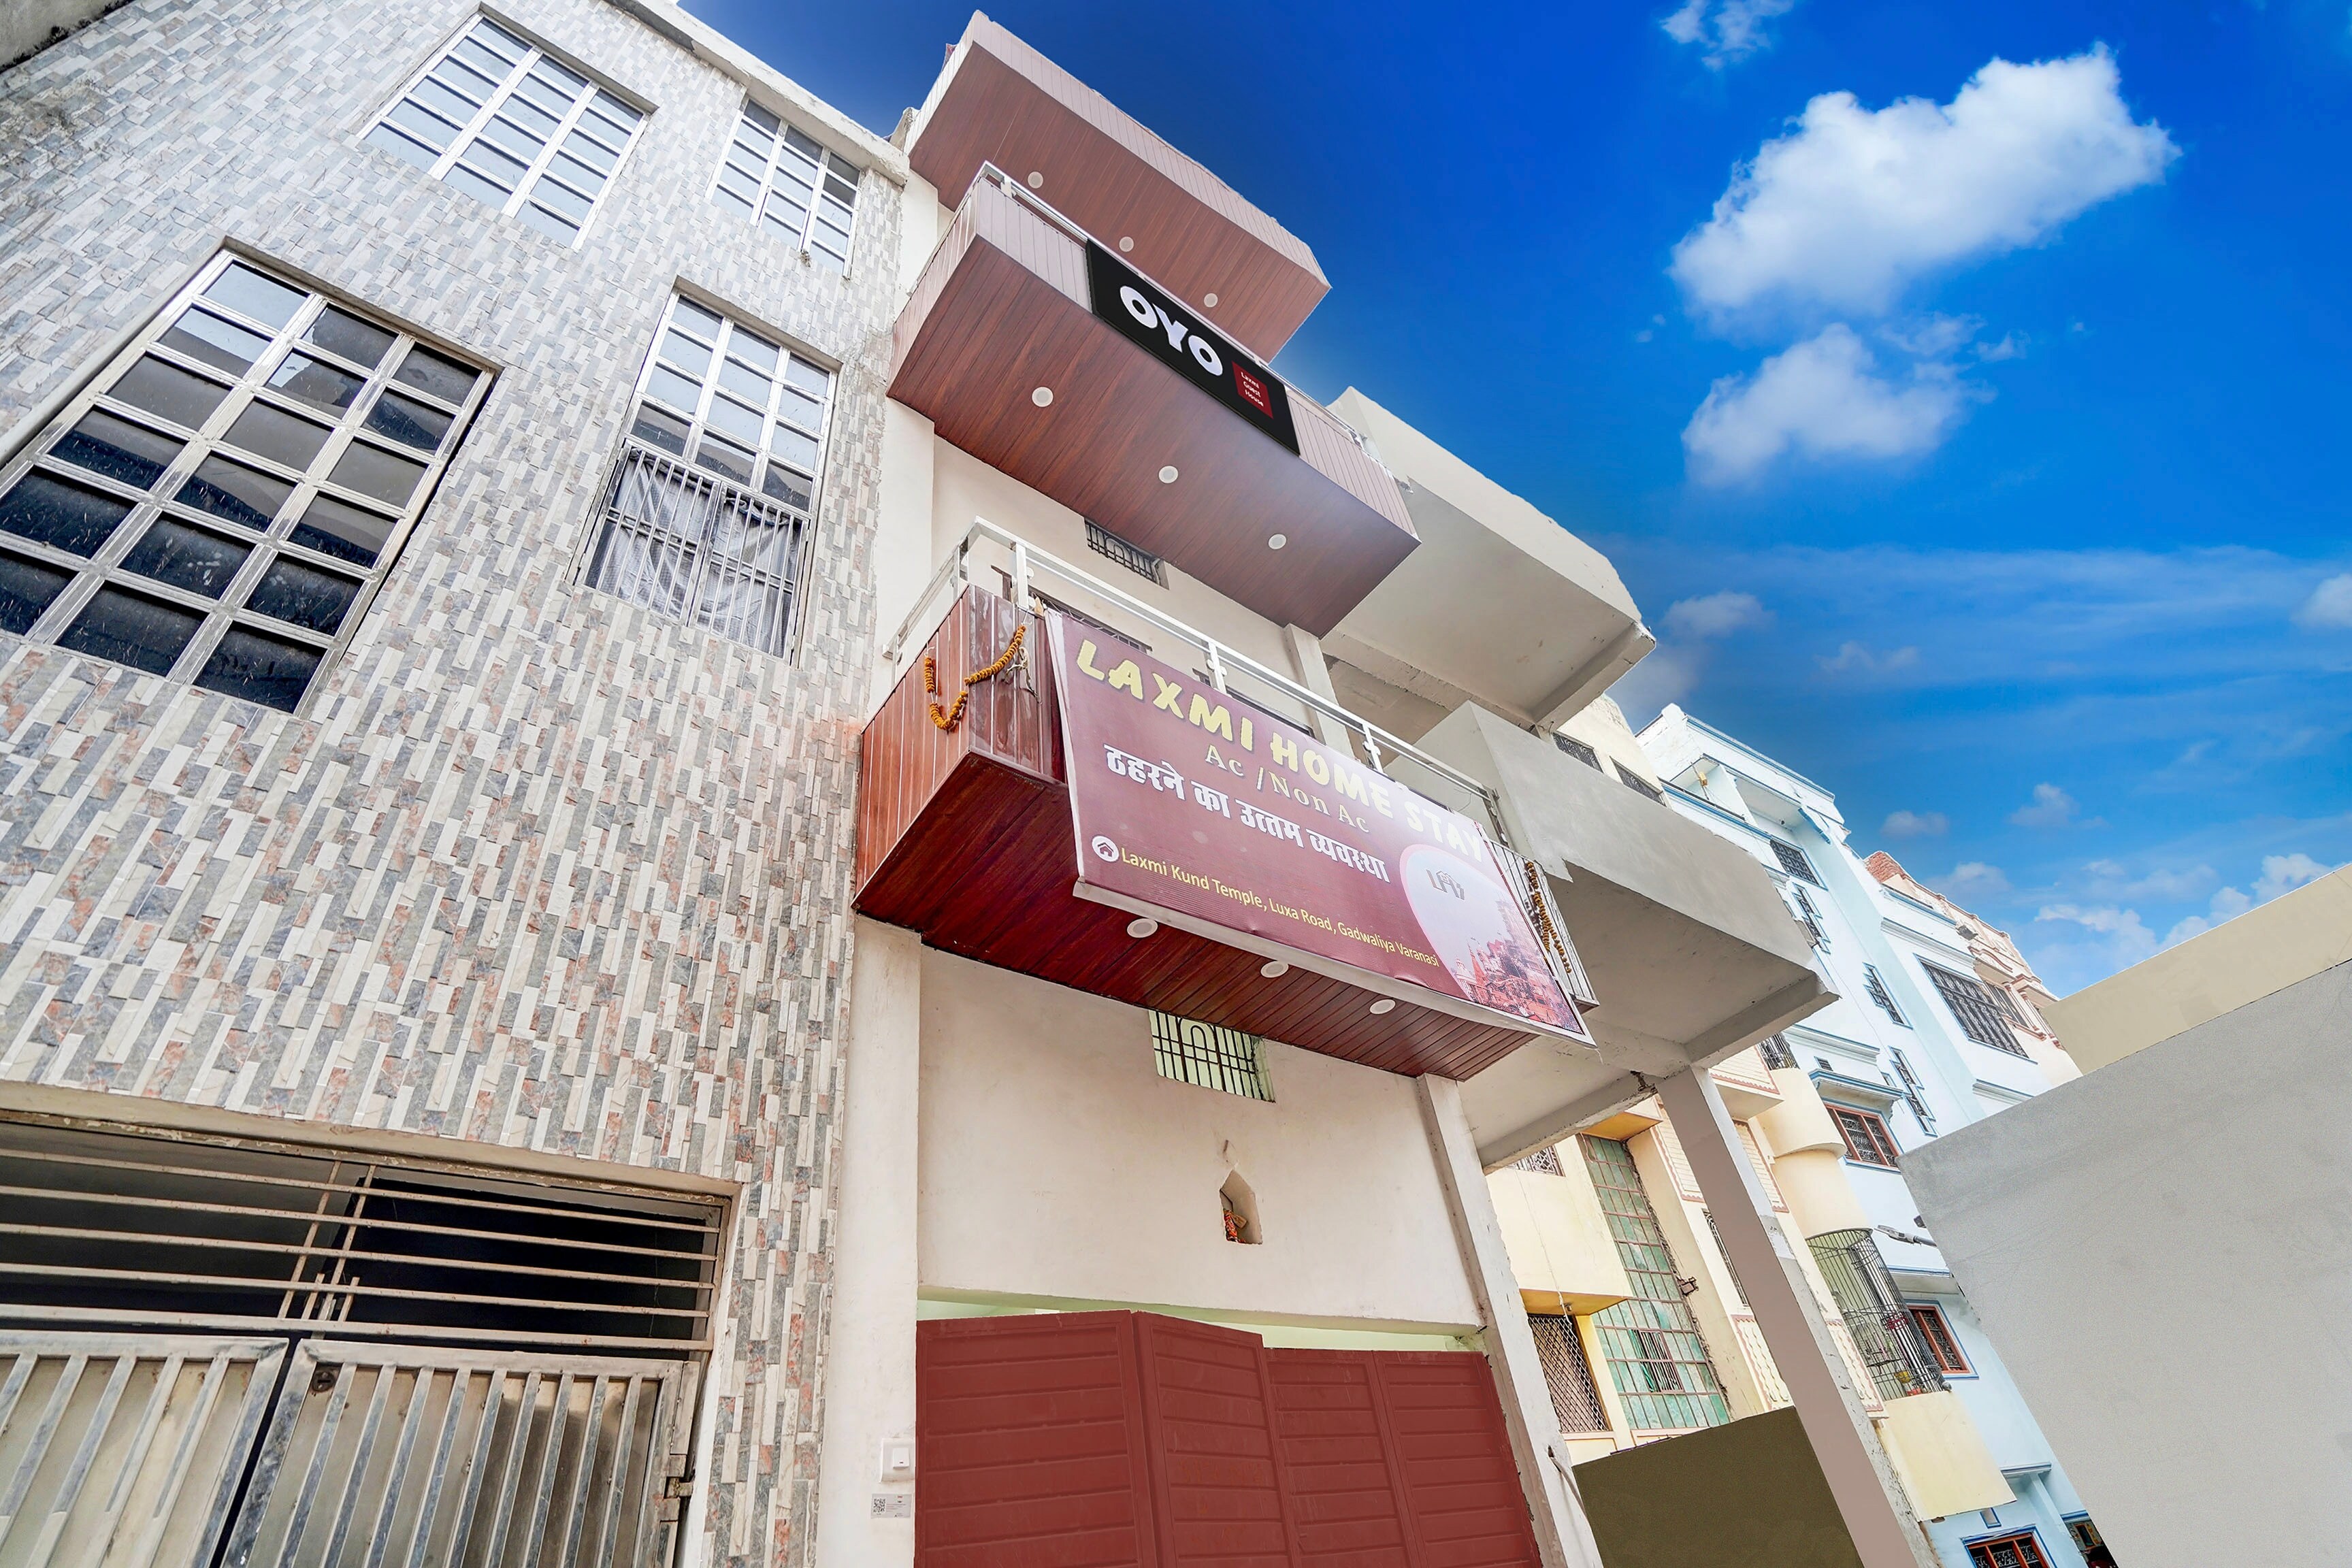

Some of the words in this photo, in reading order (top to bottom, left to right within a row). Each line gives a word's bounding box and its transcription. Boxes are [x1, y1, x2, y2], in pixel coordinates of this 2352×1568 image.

[1120, 286, 1223, 376] OYO
[1077, 638, 1253, 751] LAXMI
[1269, 732, 1394, 819] HOME
[1405, 800, 1483, 862] STAY
[1205, 745, 1245, 777] Ac
[1338, 804, 1370, 832] Ac
[1103, 743, 1186, 800] ठहरने
[1191, 781, 1231, 819] का
[1235, 798, 1305, 849] उत्तम
[1305, 828, 1391, 883] व्यवस्था
[1121, 847, 1168, 877] Laxmi
[1171, 864, 1211, 891] Kund
[1211, 878, 1268, 912] Temple,
[1268, 897, 1300, 921] Luxa
[1301, 908, 1337, 935] Road,
[1337, 921, 1396, 953] Gadwaliya
[1395, 941, 1440, 968] Varanasi
